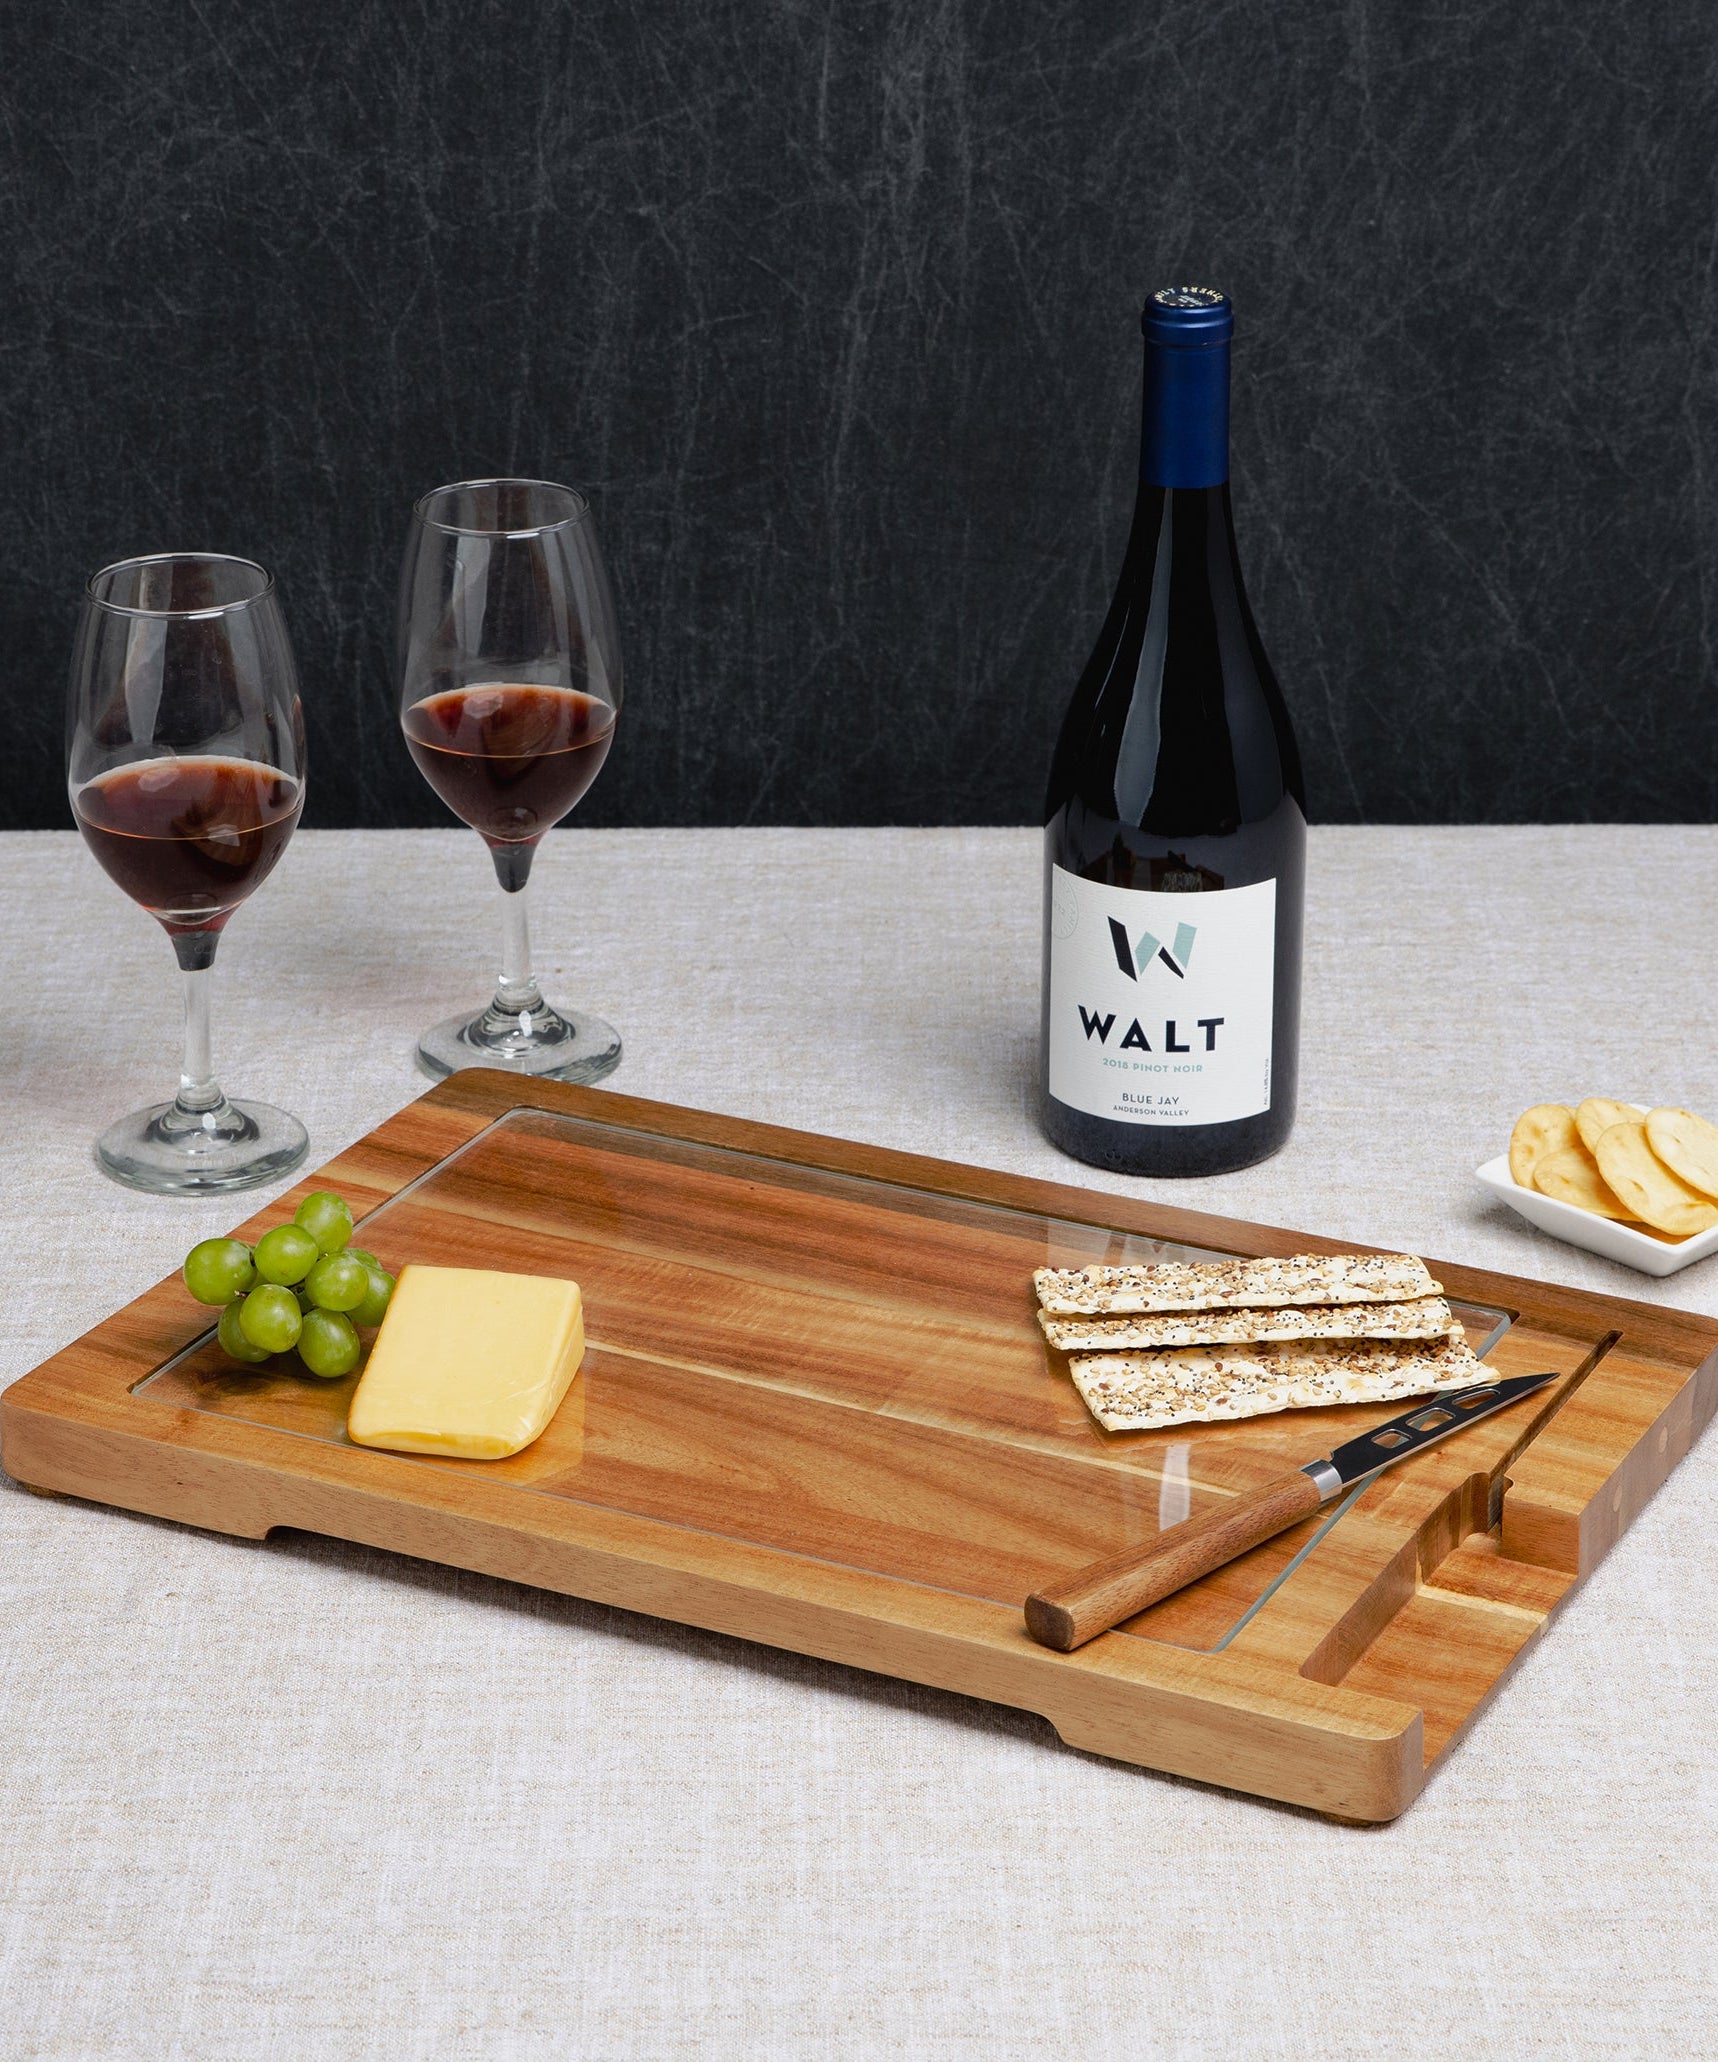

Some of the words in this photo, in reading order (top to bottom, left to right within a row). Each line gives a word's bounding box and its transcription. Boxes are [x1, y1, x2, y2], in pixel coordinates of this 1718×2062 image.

[1077, 1004, 1225, 1053] WALT
[1133, 1063, 1169, 1073] PINOT
[1173, 1064, 1203, 1073] NOIR
[1122, 1092, 1153, 1105] BLUE
[1157, 1096, 1180, 1105] JAY
[1113, 1105, 1157, 1116] ANDERSON
[1159, 1109, 1190, 1117] VALLEY
